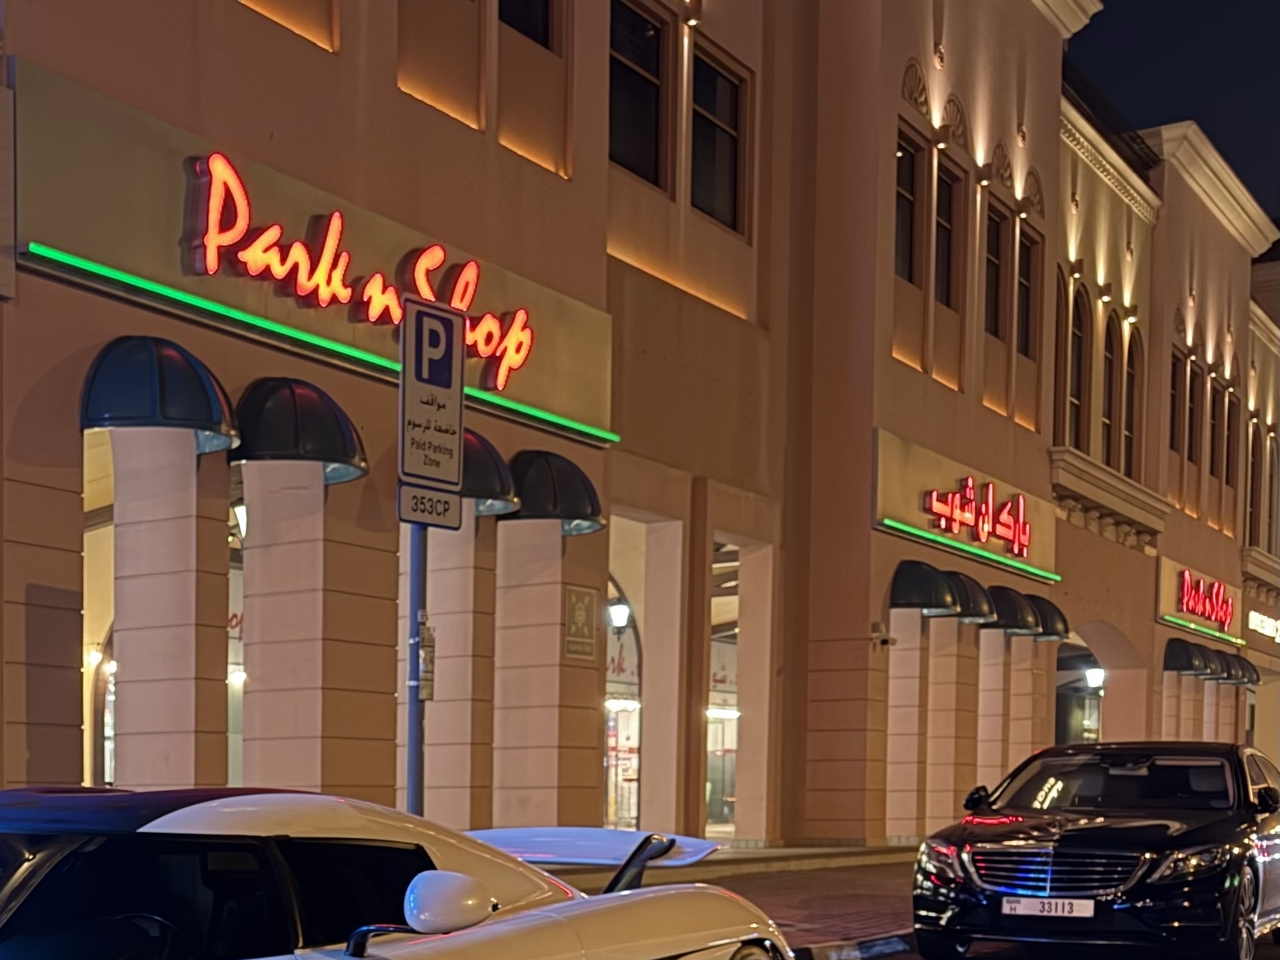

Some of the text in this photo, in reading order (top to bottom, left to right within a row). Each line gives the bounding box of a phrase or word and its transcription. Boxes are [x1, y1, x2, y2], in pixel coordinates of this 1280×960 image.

[204, 152, 352, 308] Park
[363, 272, 404, 325] n
[421, 316, 447, 379] P
[419, 392, 446, 411] مواقف
[410, 437, 453, 460] Paid Parking
[423, 454, 441, 469] Zone
[411, 495, 450, 517] 353CP
[1039, 901, 1074, 914] 33113
